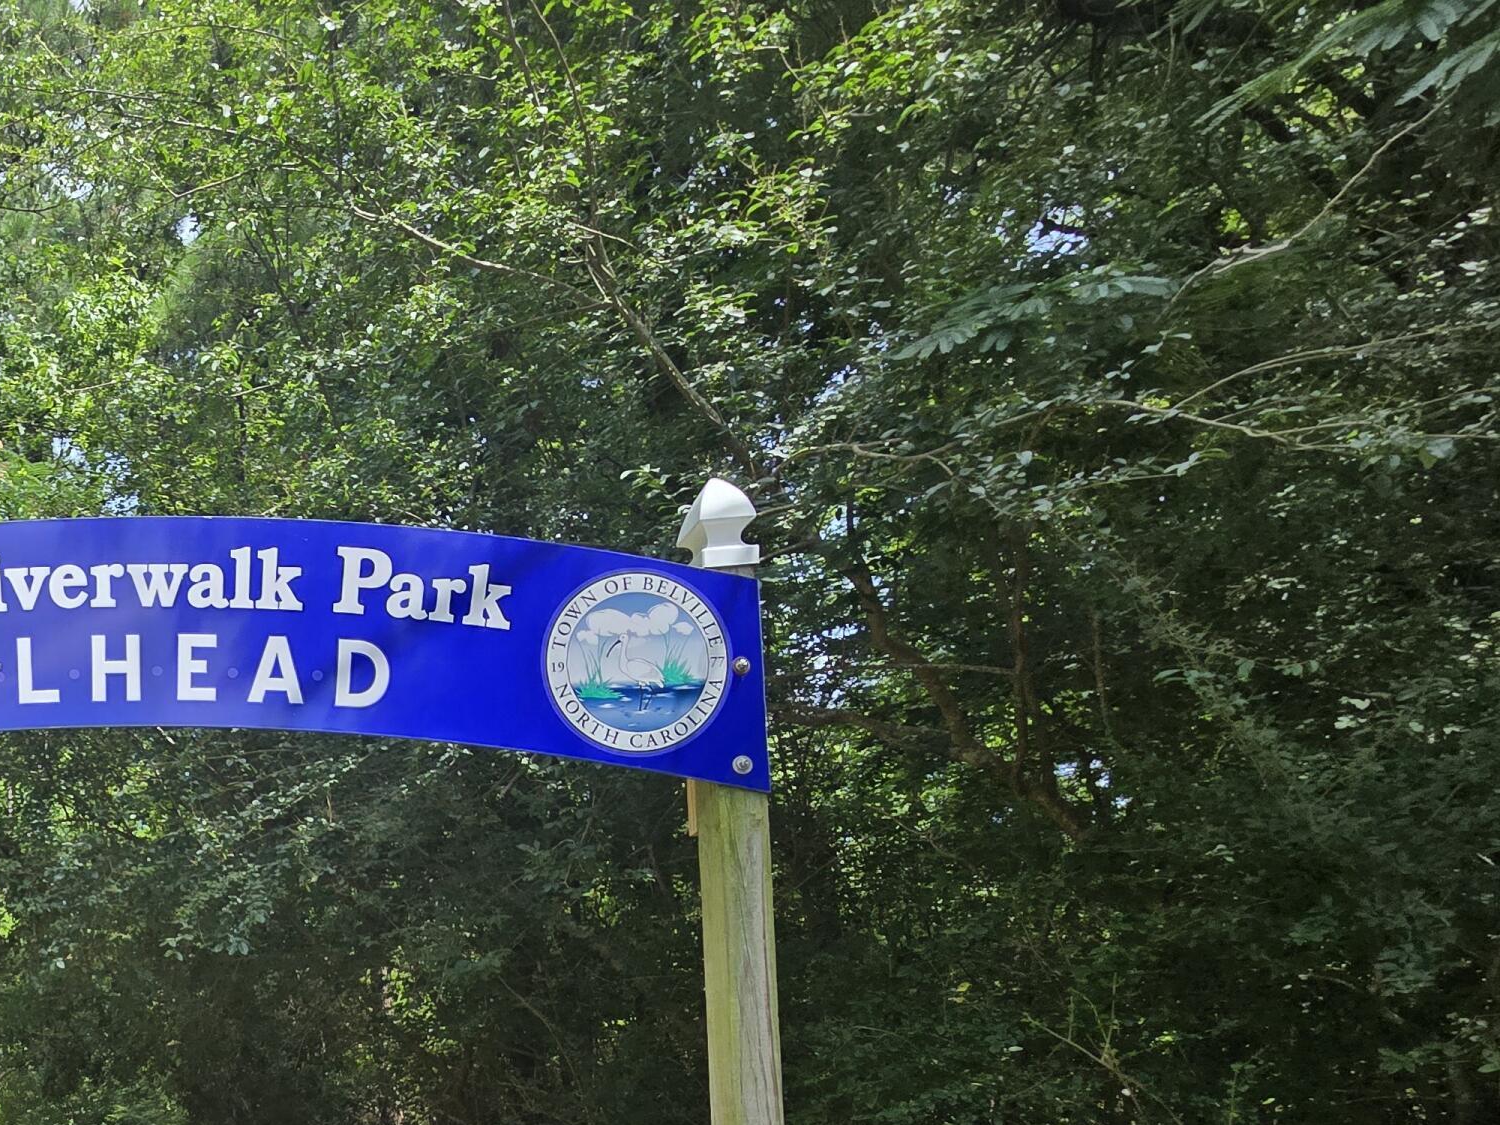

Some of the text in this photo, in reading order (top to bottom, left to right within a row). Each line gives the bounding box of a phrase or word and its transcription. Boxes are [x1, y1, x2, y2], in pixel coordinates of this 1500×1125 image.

[333, 546, 512, 630] Park
[552, 576, 723, 650] TOWN OF BELVILLE
[551, 661, 565, 673] 19
[711, 656, 725, 668] 77
[555, 679, 723, 748] NORTH CAROLINA
